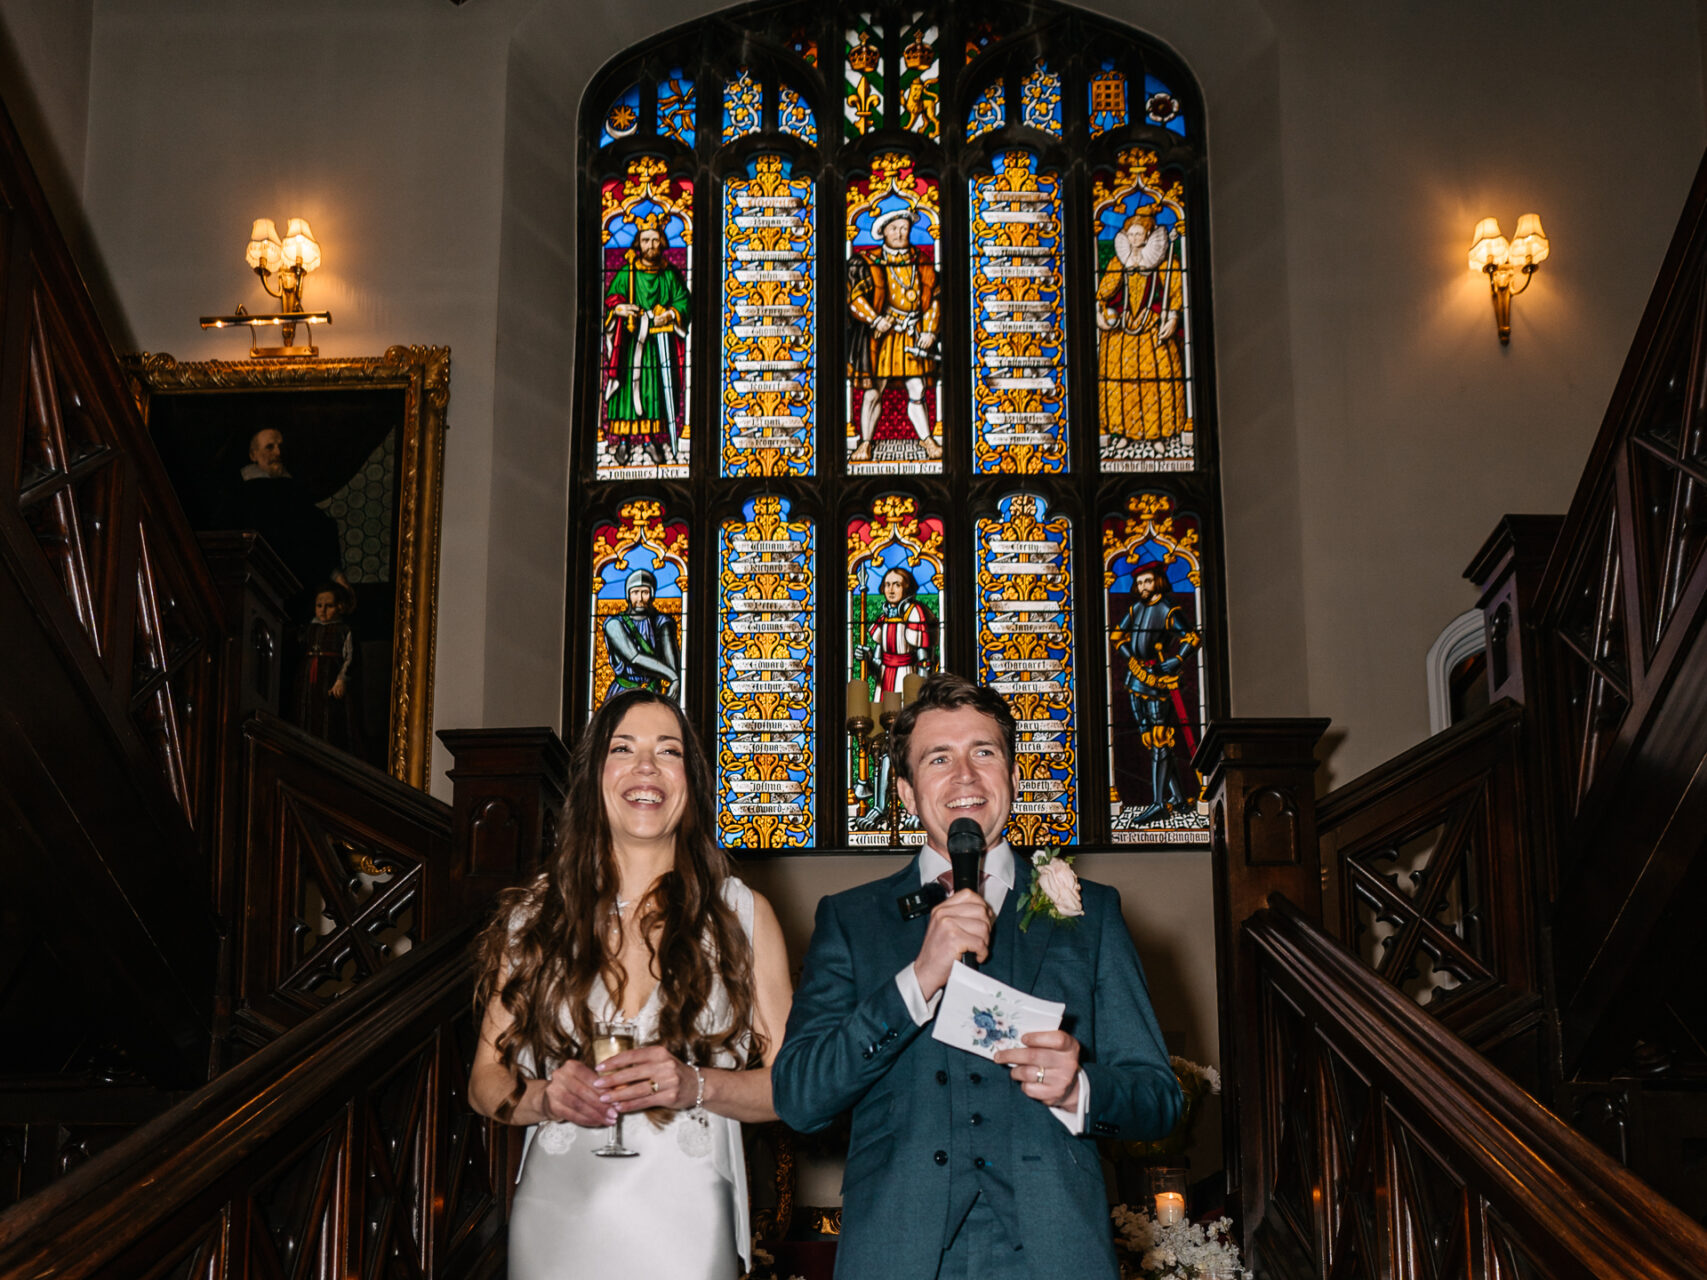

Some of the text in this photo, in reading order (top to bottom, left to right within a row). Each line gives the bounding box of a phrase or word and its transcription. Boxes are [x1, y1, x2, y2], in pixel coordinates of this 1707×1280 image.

[661, 467, 680, 479] Rex
[750, 541, 785, 551] William
[749, 562, 784, 573] Richard
[747, 622, 783, 632] Thomas
[749, 659, 785, 670] Edward
[1004, 660, 1046, 671] Margaret
[751, 682, 782, 693] Arthur
[1012, 682, 1040, 693] Mary
[1018, 780, 1050, 792] izabeth
[747, 803, 783, 814] Edward
[1111, 832, 1209, 844] Sir Richard Bingham
